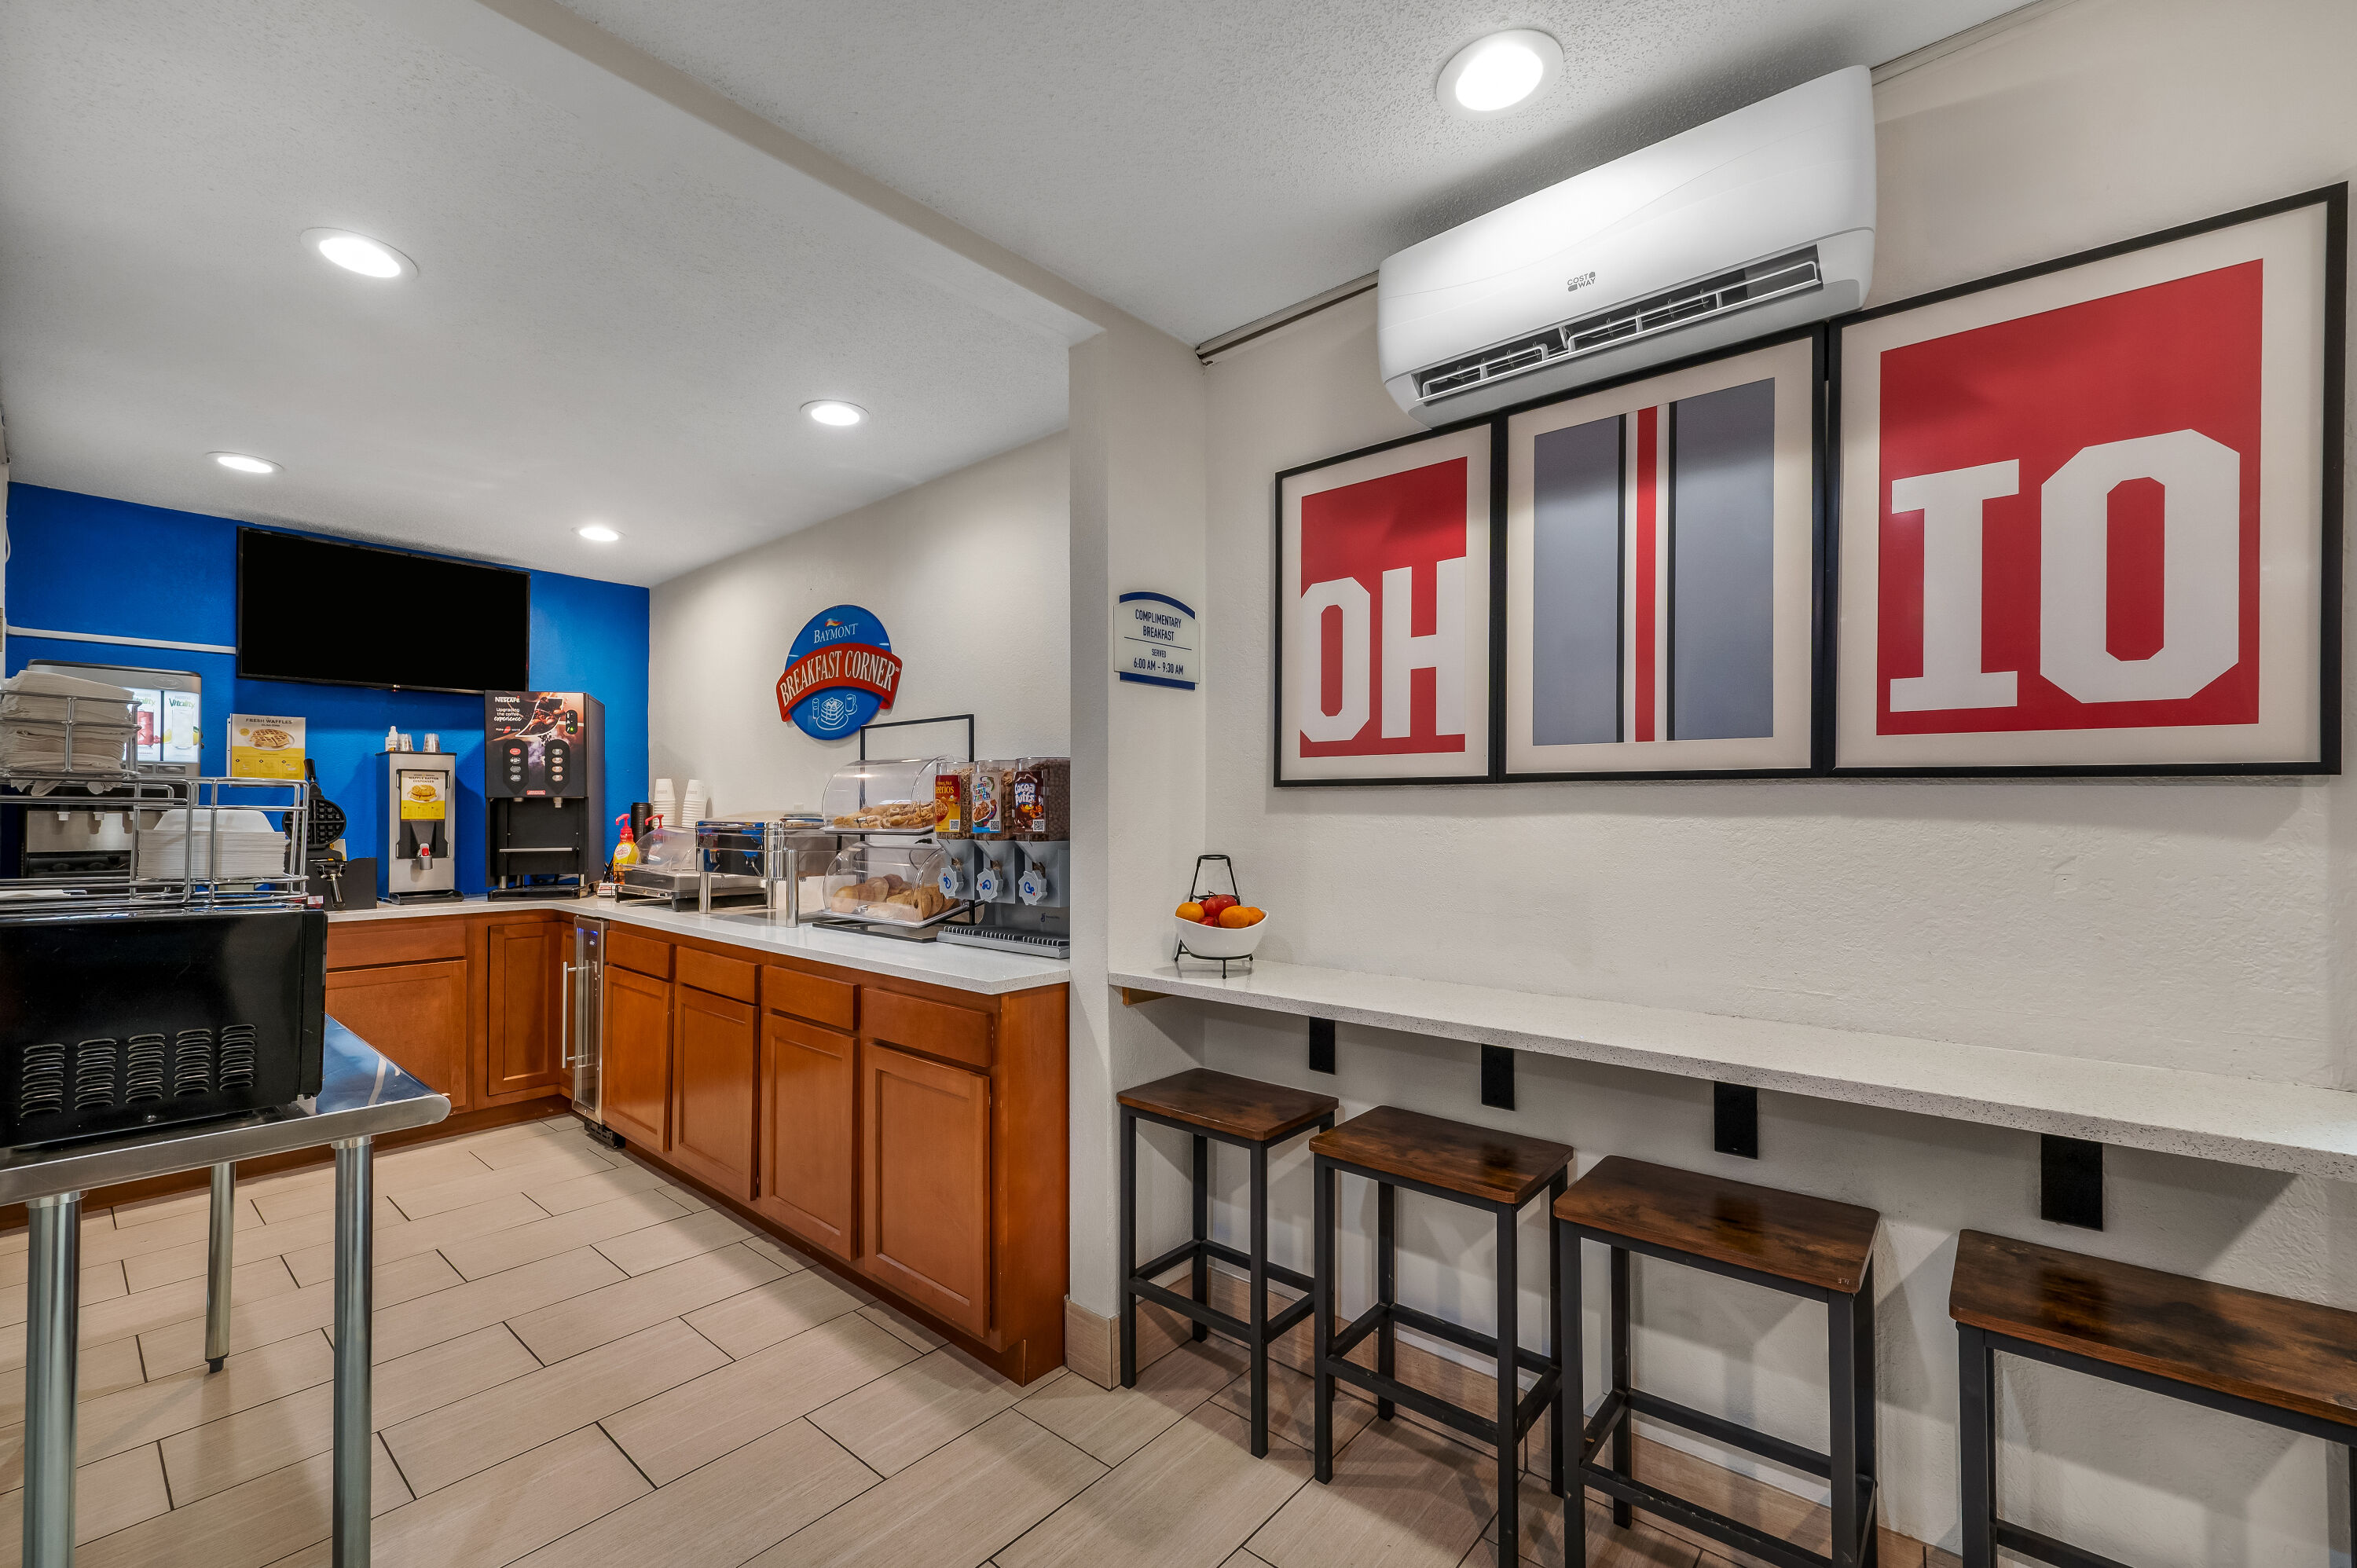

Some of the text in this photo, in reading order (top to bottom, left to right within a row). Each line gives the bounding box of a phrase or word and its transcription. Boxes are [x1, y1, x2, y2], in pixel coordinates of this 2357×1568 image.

[1567, 273, 1589, 286] COST
[1578, 277, 1596, 288] WAY
[1890, 428, 2241, 713] IO
[1135, 609, 1182, 628] COMPLIMENTARY
[814, 623, 857, 643] BAYMONT
[1142, 626, 1175, 642] BREAKFAST
[1151, 648, 1167, 658] SERVED
[1300, 556, 1467, 743] OH
[1133, 658, 1146, 669] 6:00
[1147, 660, 1156, 671] AM
[1162, 662, 1174, 674] 9:30
[1175, 665, 1184, 675] AM
[780, 650, 896, 707] BREAKFAST CORNER
[169, 698, 195, 709] Vitality
